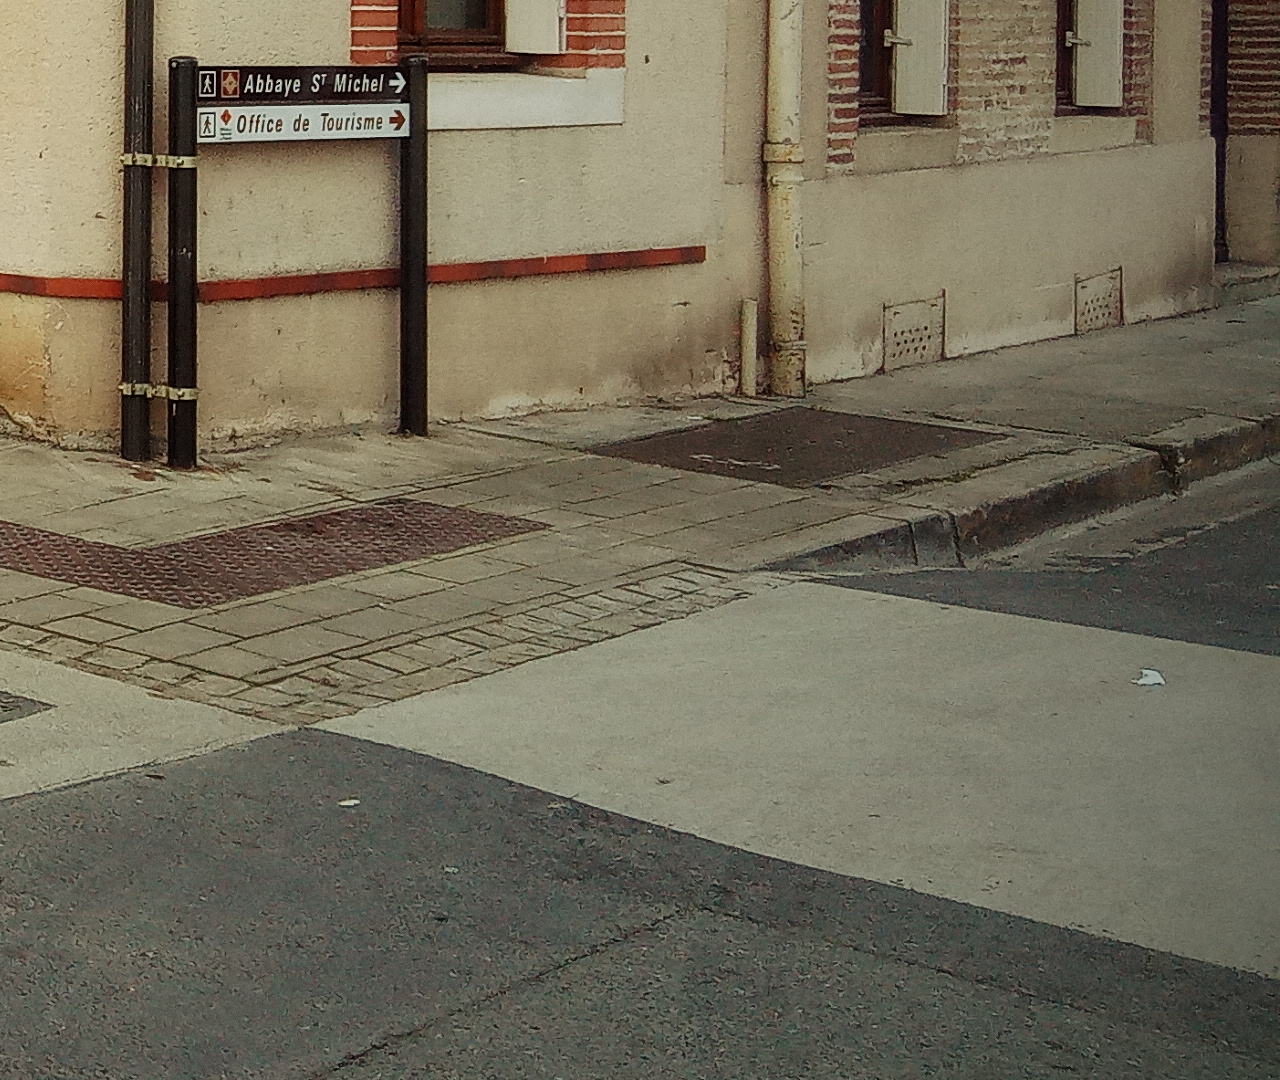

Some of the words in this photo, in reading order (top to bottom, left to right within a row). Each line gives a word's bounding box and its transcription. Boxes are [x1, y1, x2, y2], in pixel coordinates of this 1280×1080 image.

[243, 73, 301, 97] Abbaye
[333, 72, 384, 93] Michel
[236, 113, 284, 134] Office
[293, 113, 310, 133] de
[321, 111, 383, 132] Tourisme
